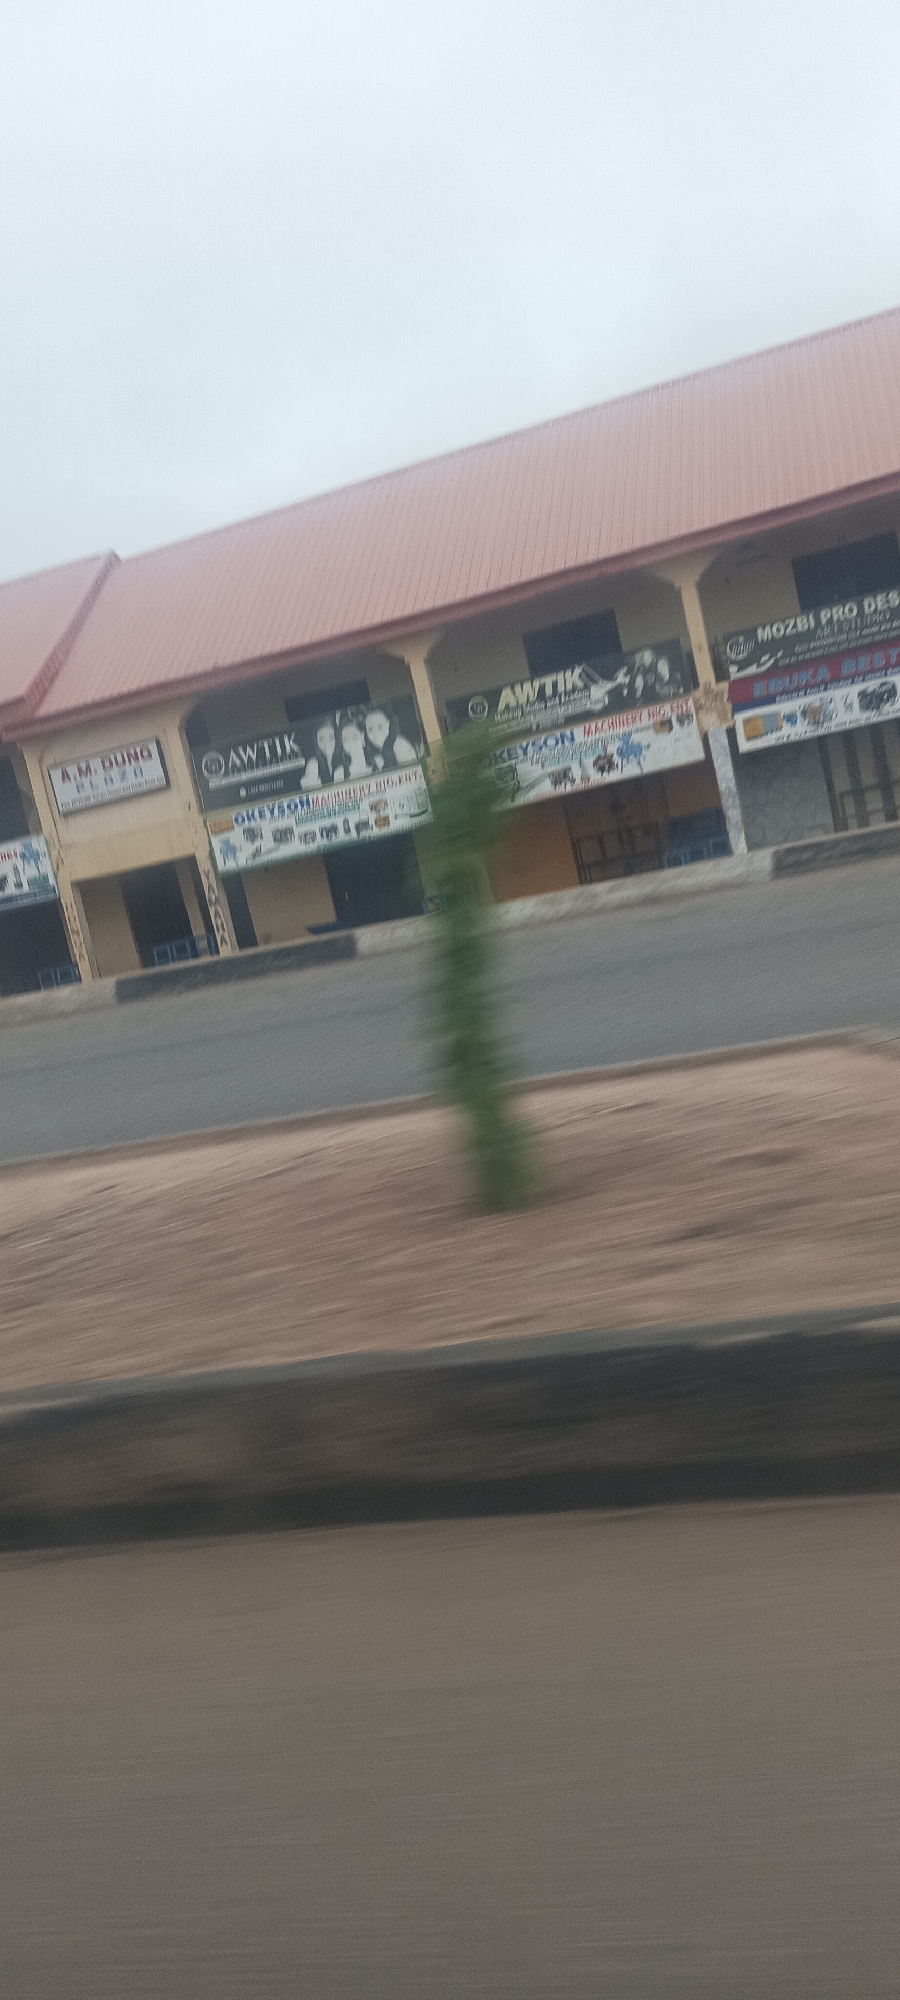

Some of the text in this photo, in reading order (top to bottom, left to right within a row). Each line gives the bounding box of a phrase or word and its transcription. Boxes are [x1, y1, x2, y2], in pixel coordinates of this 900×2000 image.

[756, 612, 815, 643] MOZBI
[820, 602, 857, 625] PRO
[497, 664, 585, 713] AWTIK
[229, 731, 300, 770] AWTIK
[233, 794, 311, 827] OKEYSON
